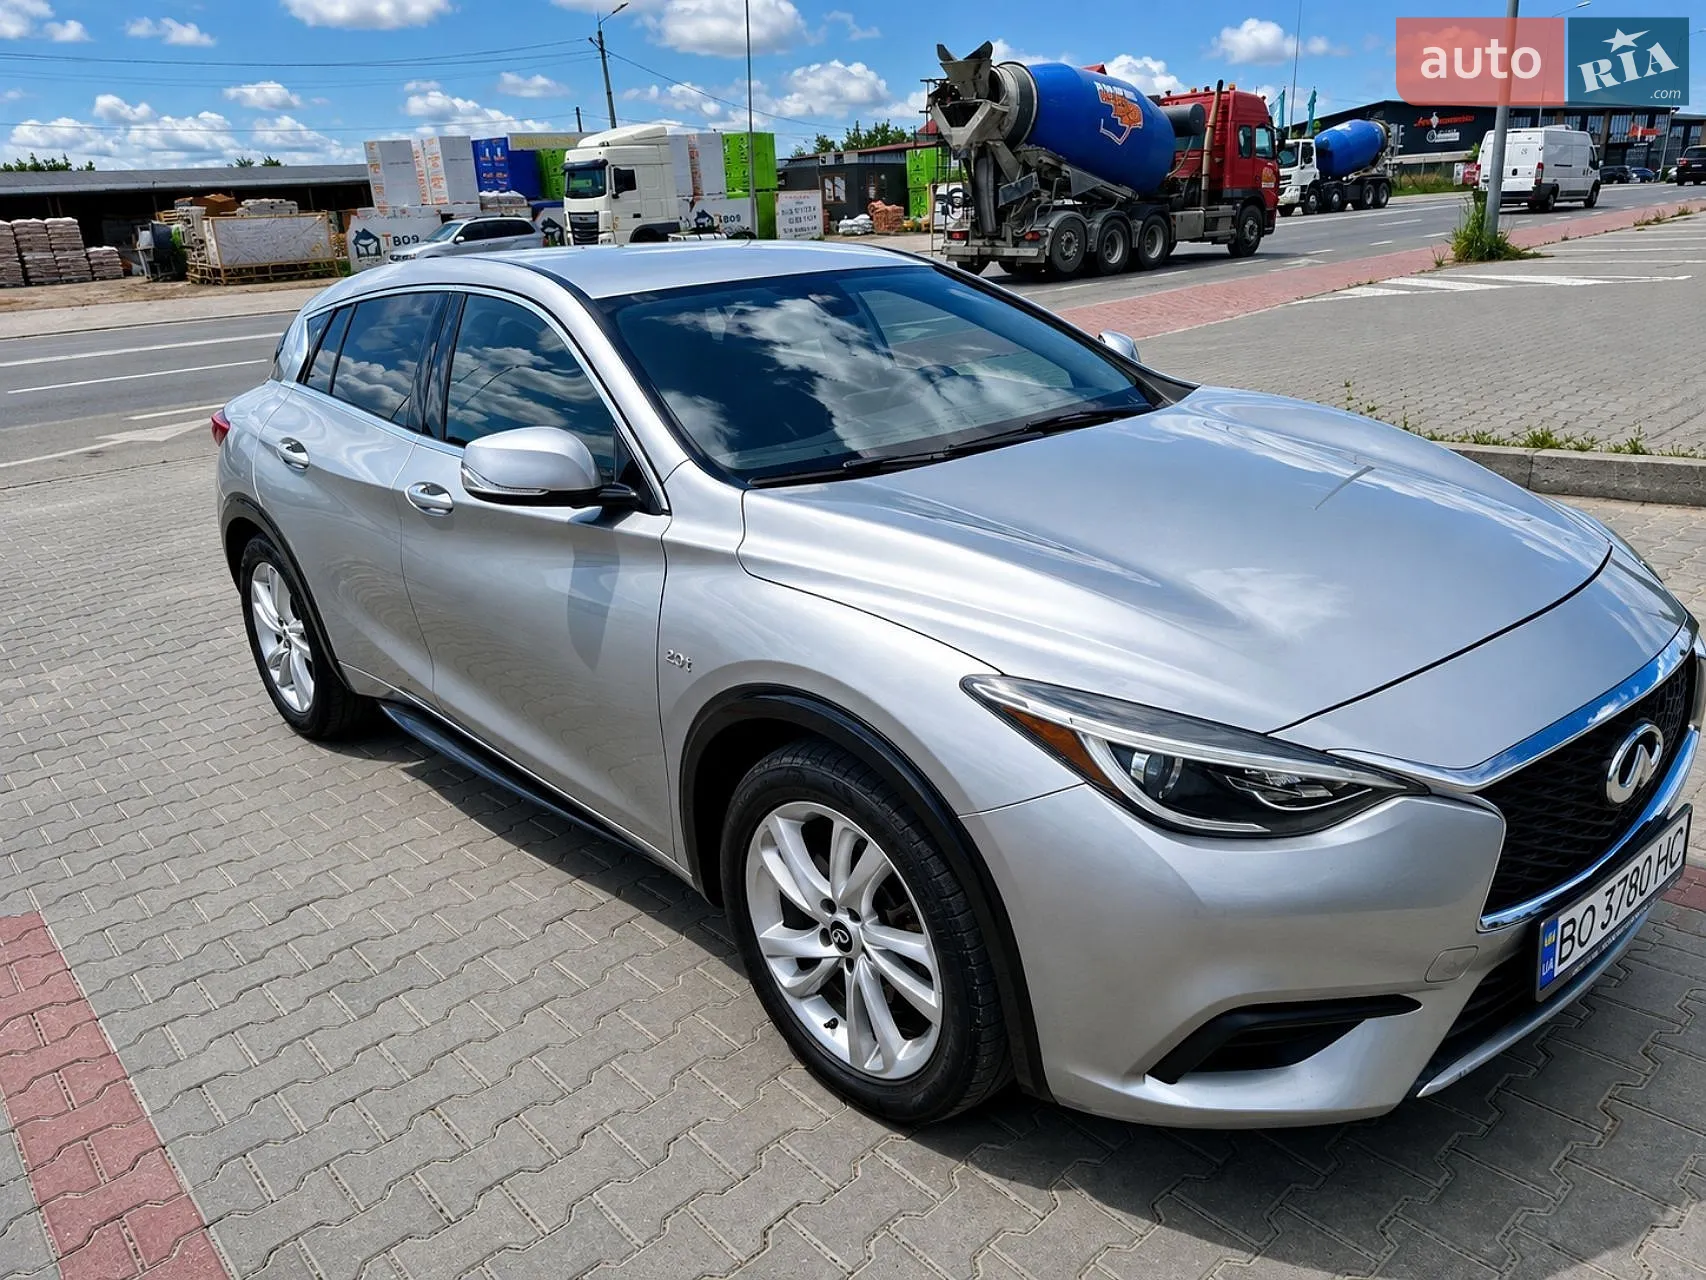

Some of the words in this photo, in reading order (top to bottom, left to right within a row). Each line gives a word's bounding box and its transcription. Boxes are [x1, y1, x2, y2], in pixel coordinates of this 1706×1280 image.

[1558, 904, 1596, 967] BO
[1600, 855, 1653, 930] 3780
[1653, 826, 1684, 885] HC
